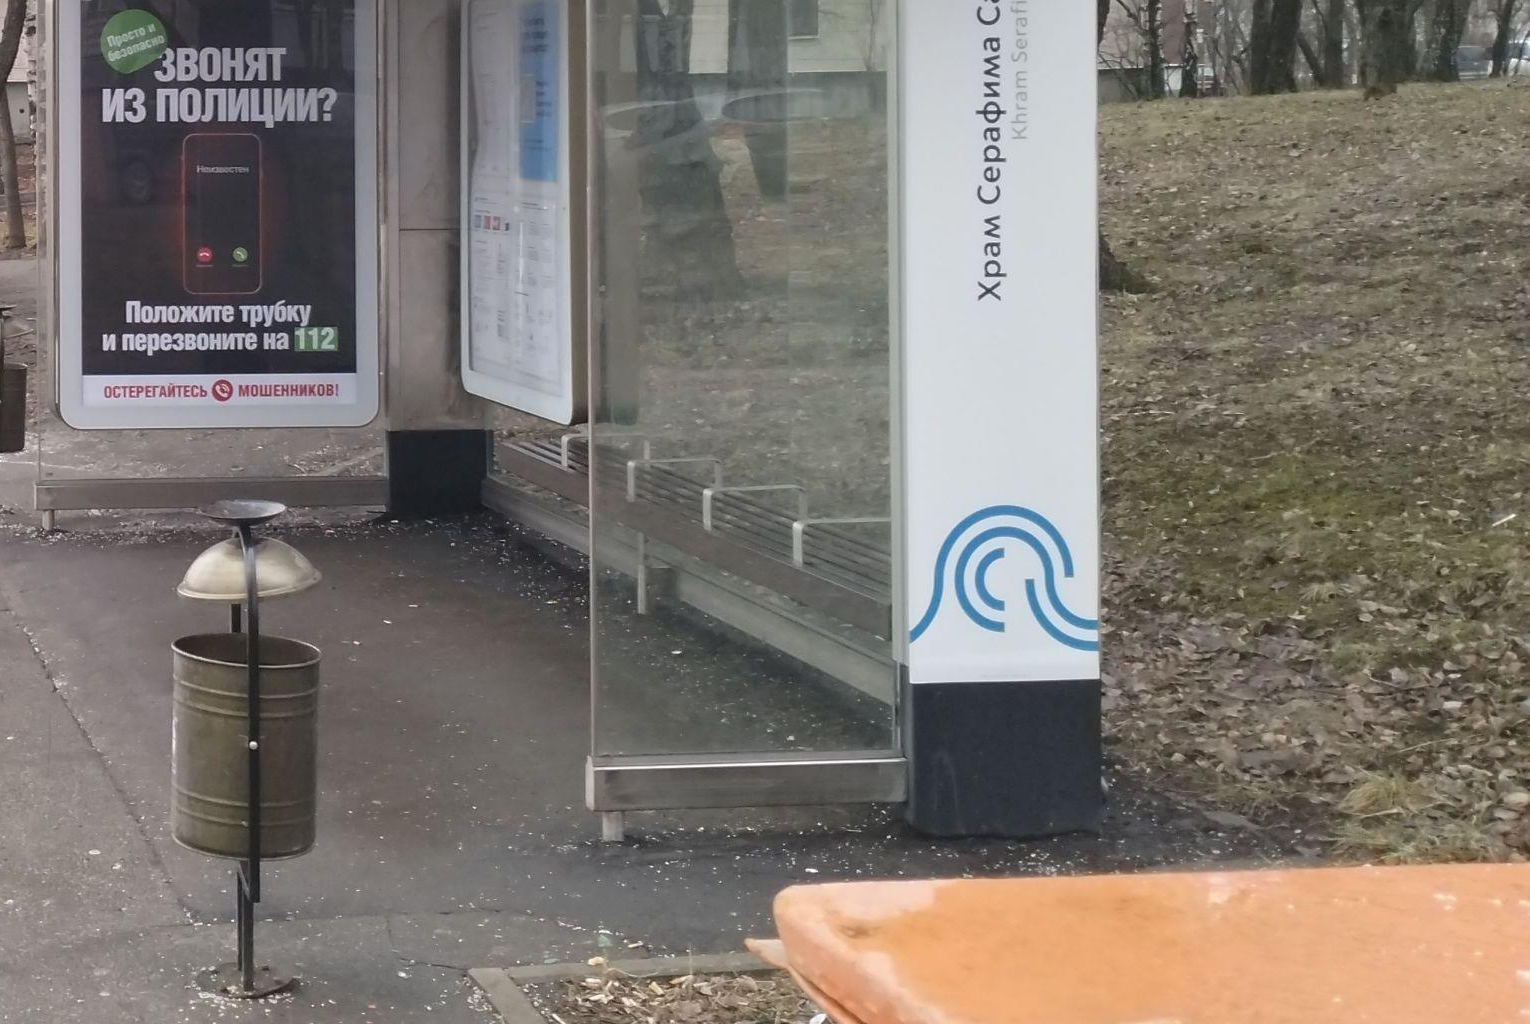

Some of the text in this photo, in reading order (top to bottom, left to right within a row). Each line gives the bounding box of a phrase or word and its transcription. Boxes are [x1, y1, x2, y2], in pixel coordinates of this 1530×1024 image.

[107, 27, 146, 47] Просто
[107, 35, 165, 62] безопасно
[154, 47, 287, 82] ЗВОНЯТ
[102, 87, 338, 128] ИЗ ПОЛИЦИИ?
[975, 36, 1006, 205] Серафима
[1011, 71, 1027, 140] Khram
[977, 214, 1006, 301] Храм
[125, 299, 312, 327] Положите трубку
[102, 326, 336, 356] и перезвоните на 112
[104, 383, 339, 399] ОСТЕРЕГАЙТЕСЬ МОШЕННИКОВ!
